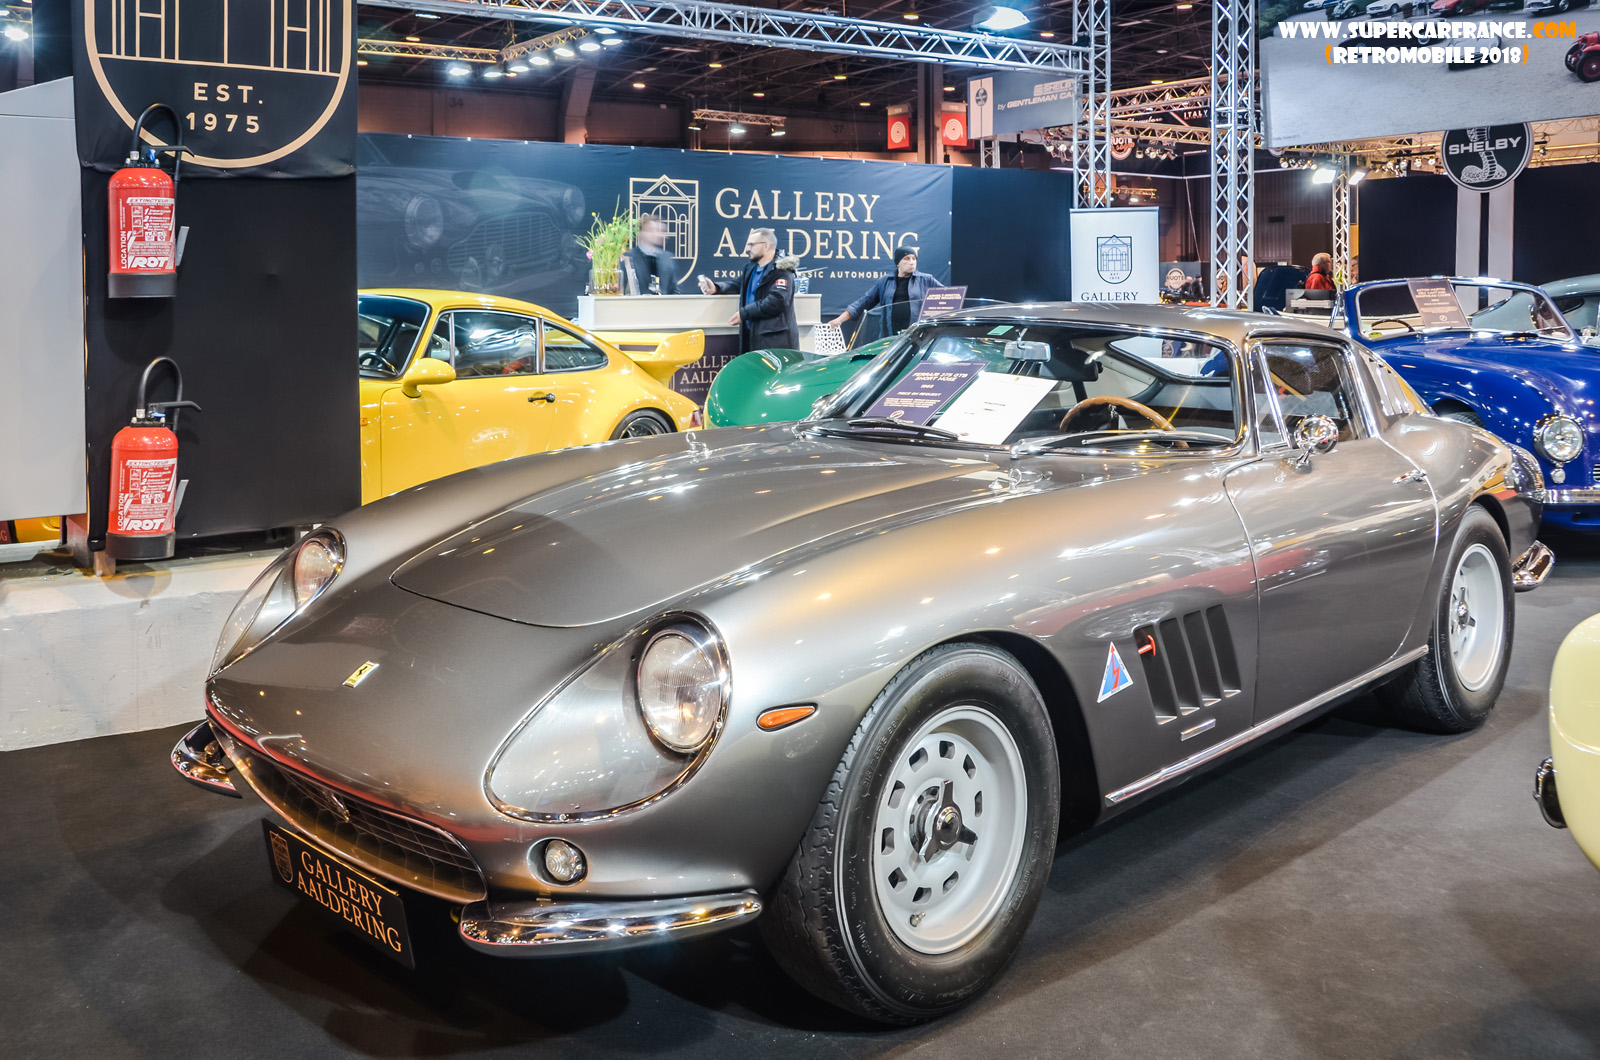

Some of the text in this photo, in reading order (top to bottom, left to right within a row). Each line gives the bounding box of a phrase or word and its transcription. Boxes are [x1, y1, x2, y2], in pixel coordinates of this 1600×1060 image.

[193, 82, 263, 105] EST.
[1006, 94, 1058, 109] GENTLEMAN
[185, 112, 260, 134] 1975
[1184, 110, 1208, 119] ITALY
[1448, 136, 1522, 155] SHELBY
[715, 187, 881, 223] GALLERY
[1080, 291, 1139, 301] GALLERY
[301, 851, 382, 917] GALLERY
[297, 871, 402, 952] AALDERING
